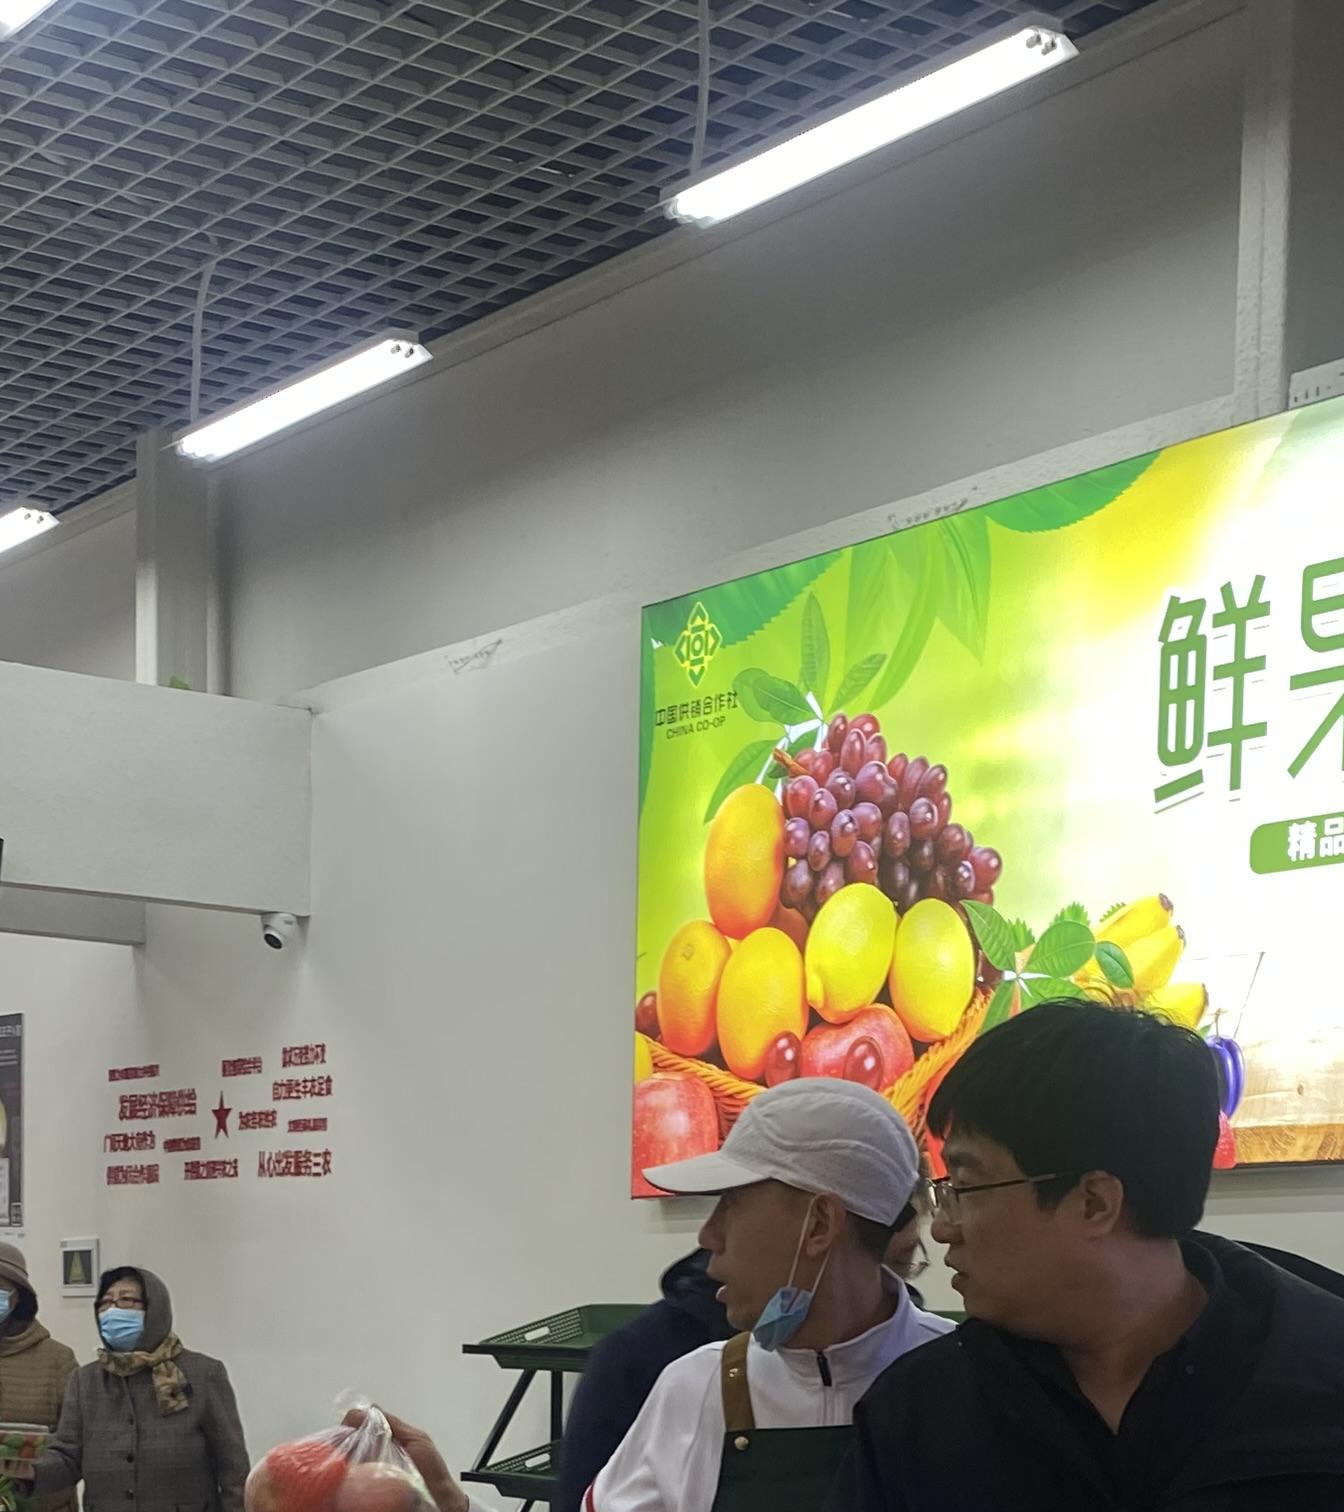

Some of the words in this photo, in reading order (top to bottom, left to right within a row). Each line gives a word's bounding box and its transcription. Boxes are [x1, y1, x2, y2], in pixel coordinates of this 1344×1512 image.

[655, 690, 739, 727] 中国供销合作社
[666, 723, 695, 740] CHINA
[696, 715, 727, 732] CO-OP
